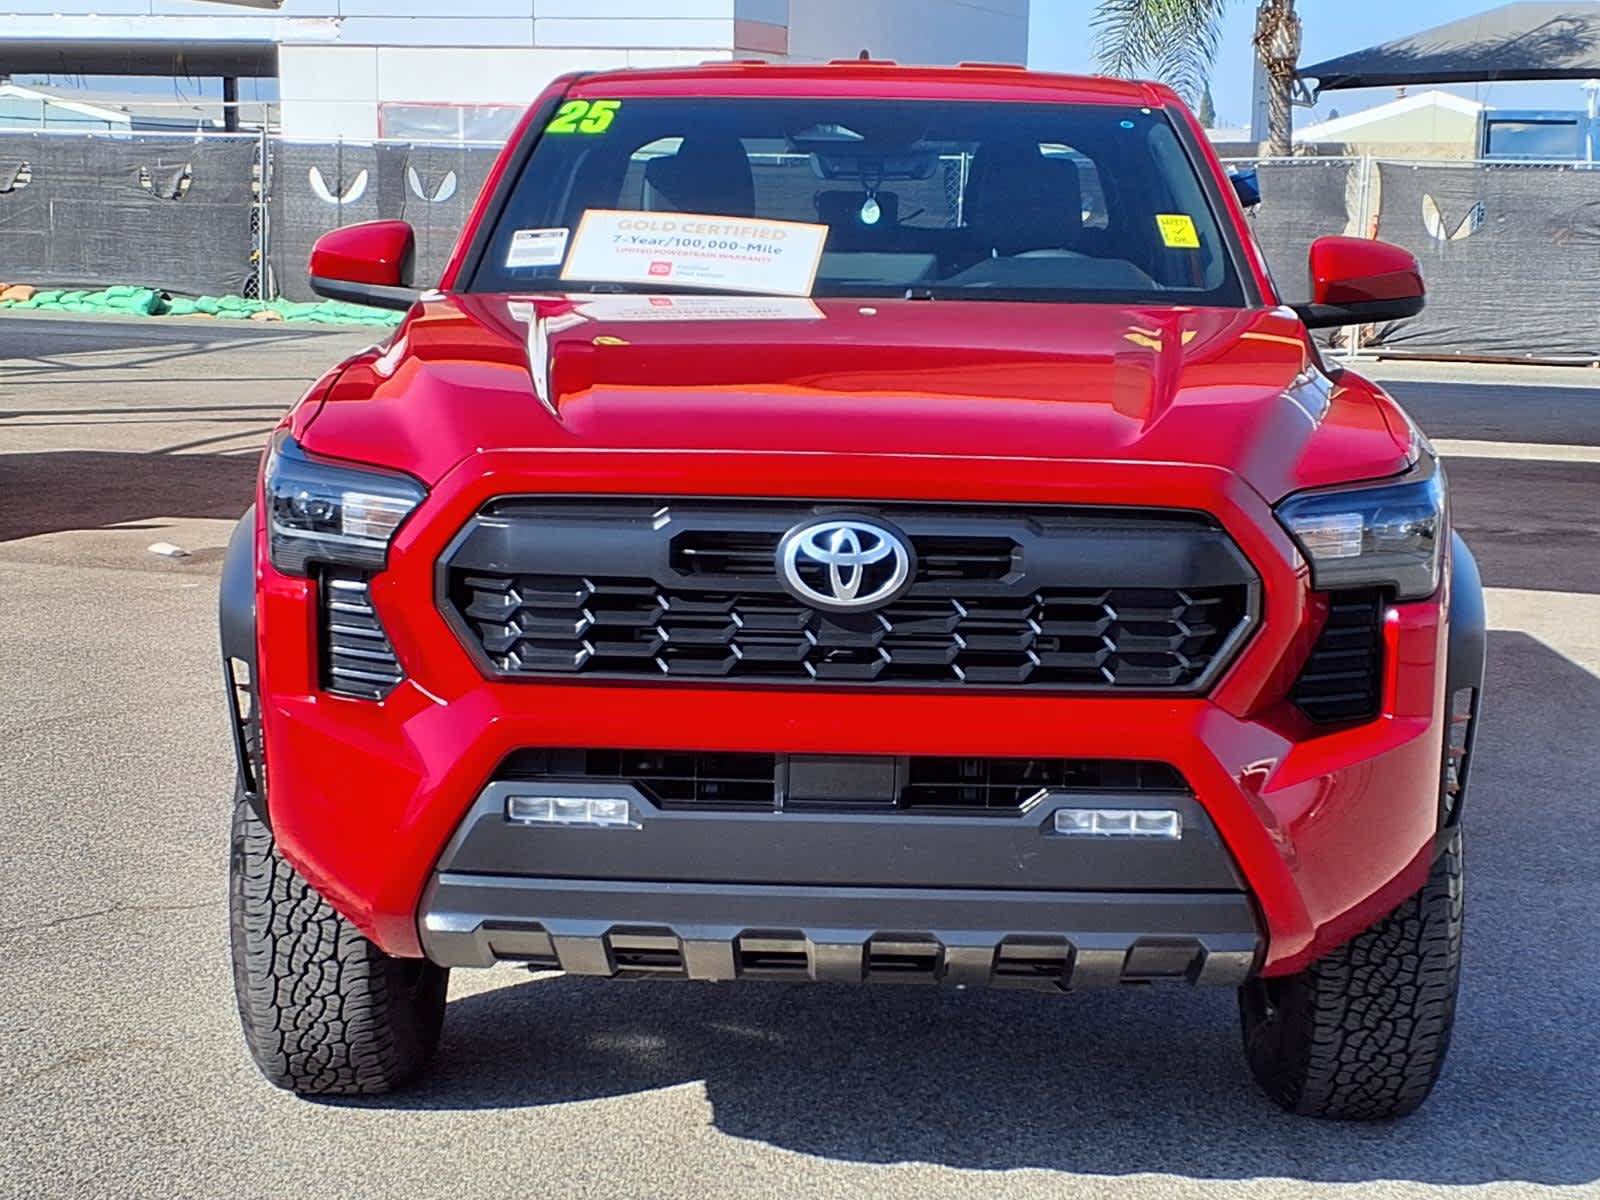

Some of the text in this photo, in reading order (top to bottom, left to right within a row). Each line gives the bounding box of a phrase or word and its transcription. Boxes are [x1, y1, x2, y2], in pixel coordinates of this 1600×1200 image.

[545, 99, 622, 134] 25
[617, 218, 787, 241] GOLD CERTIFIED
[612, 233, 783, 255] 7-Year/100,000-Mile
[615, 247, 772, 264] LIMITED POWERTRAIN WARRANTY
